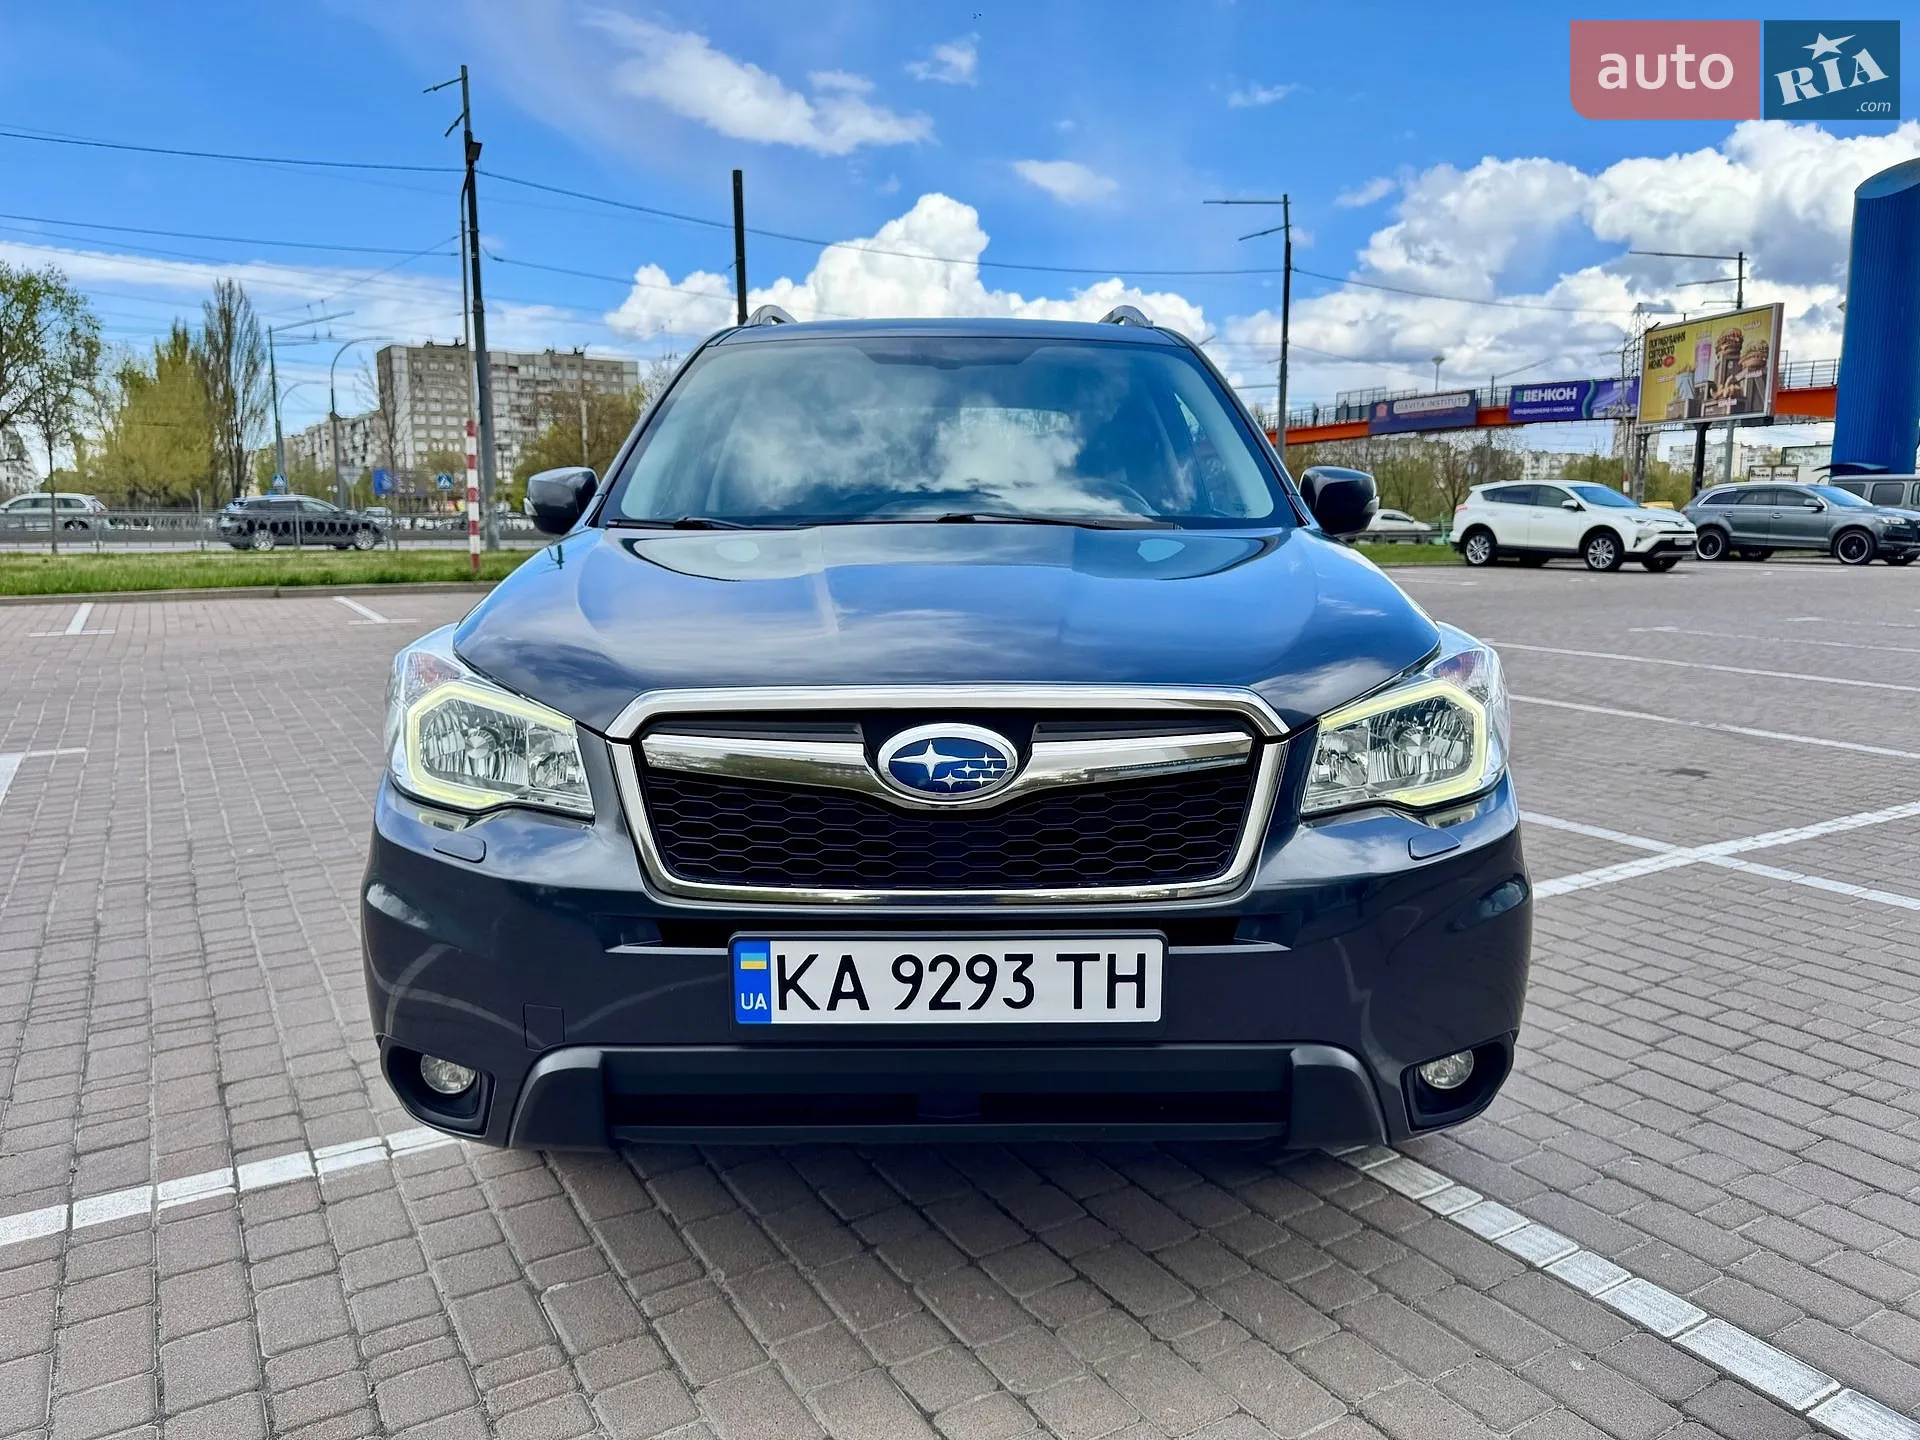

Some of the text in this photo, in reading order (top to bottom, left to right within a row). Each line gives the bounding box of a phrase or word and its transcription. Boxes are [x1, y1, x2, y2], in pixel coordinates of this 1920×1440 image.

[1427, 396, 1467, 409] INSTITUTE
[1523, 387, 1578, 402] ВЕНКОН
[777, 953, 1146, 1011] KA 9293 TH
[740, 992, 768, 1010] UA
